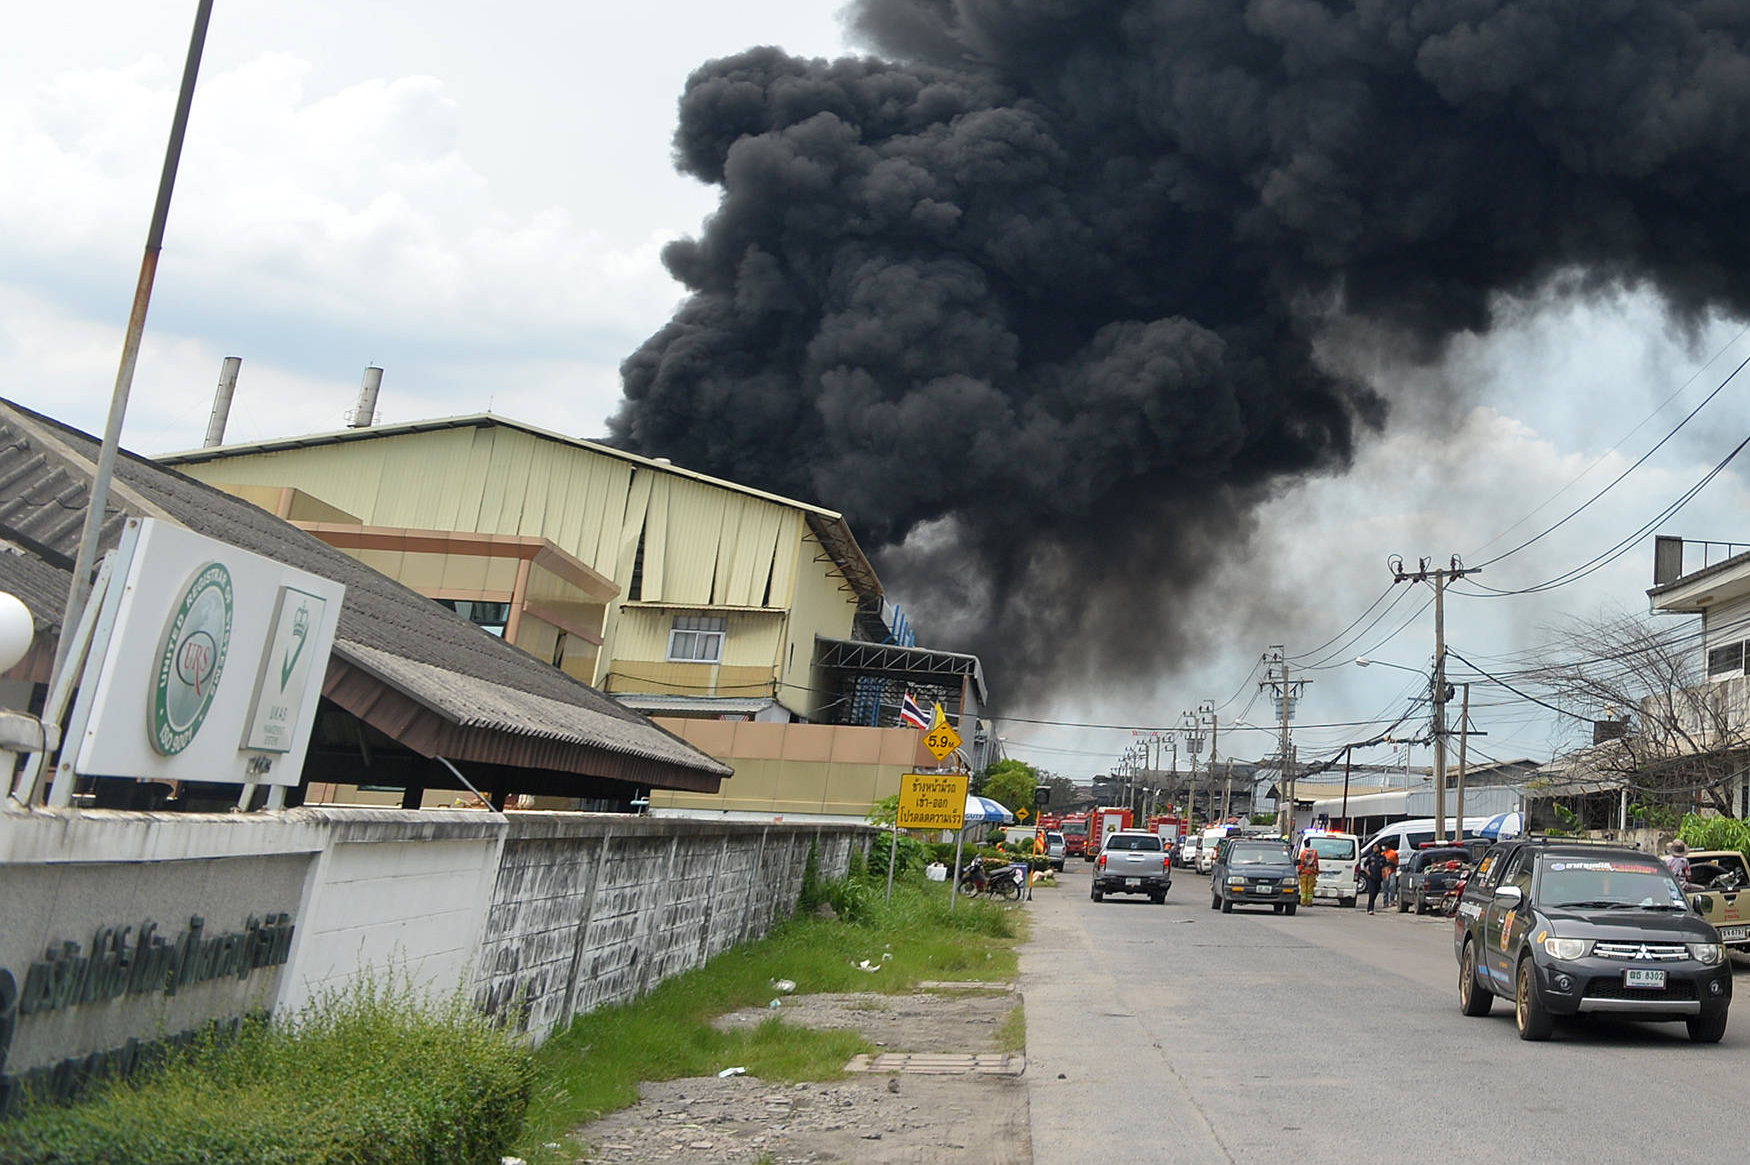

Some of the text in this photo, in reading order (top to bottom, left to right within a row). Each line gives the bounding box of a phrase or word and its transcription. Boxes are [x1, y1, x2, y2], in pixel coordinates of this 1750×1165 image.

[160, 614, 184, 688] UNITED
[184, 642, 211, 697] URS
[928, 735, 948, 748] 5.9
[916, 793, 948, 808] เข้า-ออก
